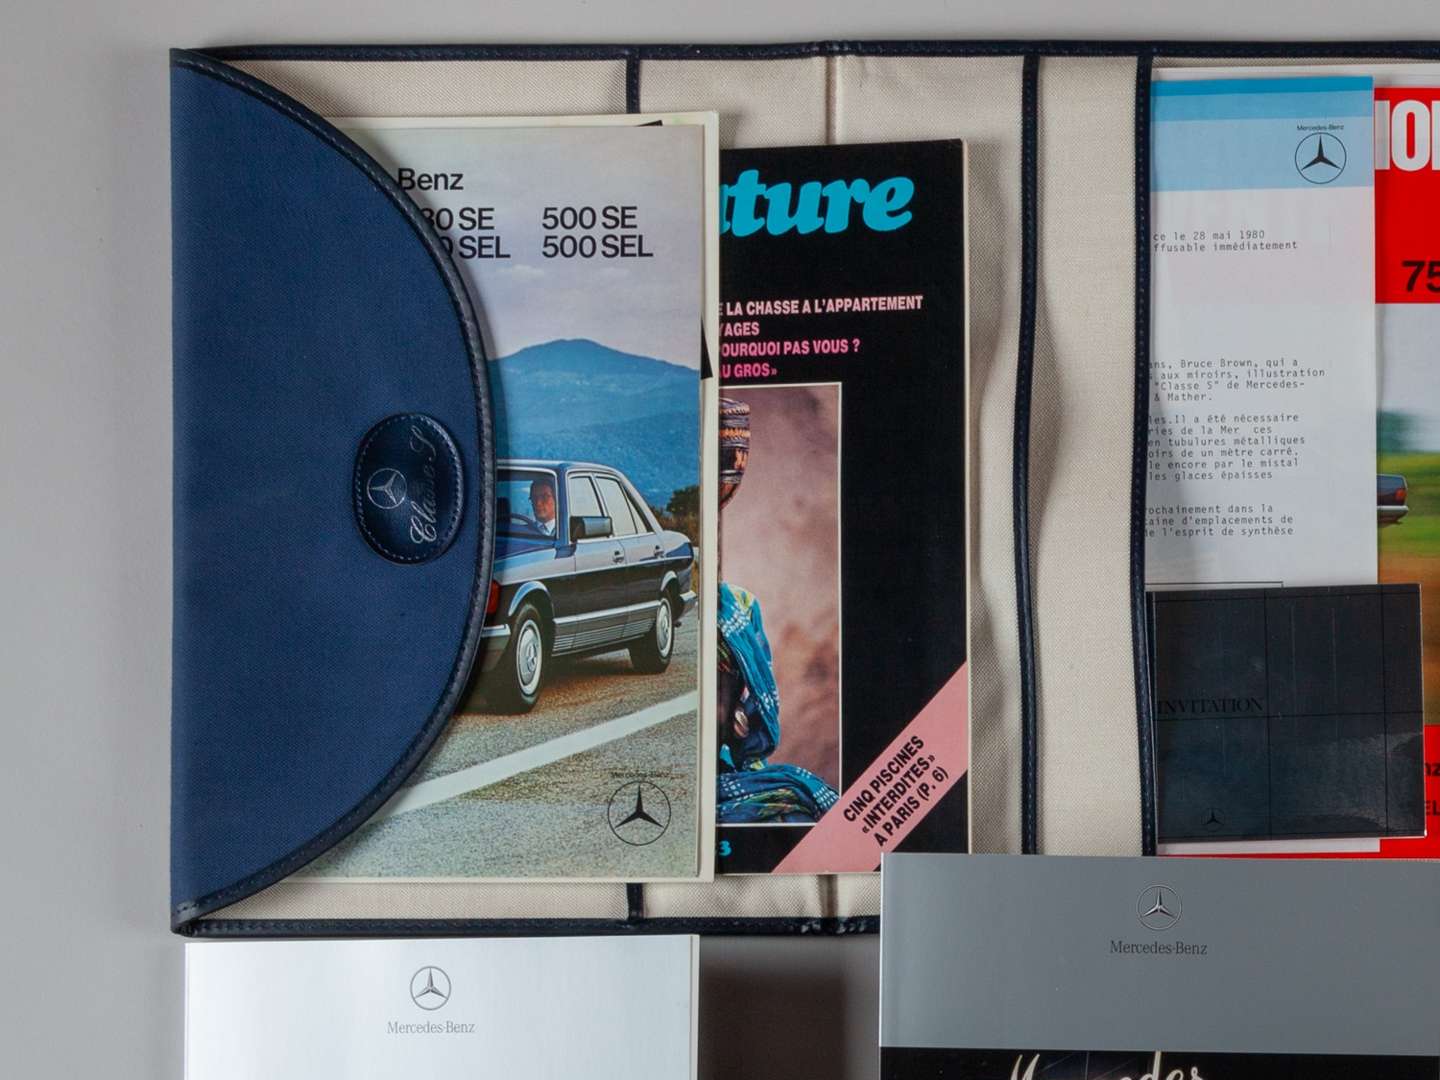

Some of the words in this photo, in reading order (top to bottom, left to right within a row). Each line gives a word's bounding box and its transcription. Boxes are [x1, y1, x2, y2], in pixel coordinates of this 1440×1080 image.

[459, 208, 494, 230] SE
[542, 207, 596, 230] 500
[601, 206, 638, 229] SE
[1193, 231, 1205, 240] 28
[1213, 231, 1231, 240] mai
[459, 235, 510, 258] SEL
[542, 235, 596, 258] 500
[601, 235, 653, 257] SEL
[727, 303, 743, 316] LA
[746, 300, 799, 315] CHASSE
[802, 300, 811, 313] A
[720, 342, 780, 357] OURQUOI
[784, 341, 809, 355] PAS
[813, 339, 848, 354] VOUS
[1226, 380, 1240, 390] de
[1180, 425, 1193, 435] de
[1180, 448, 1193, 458] de
[1214, 460, 1234, 470] par
[1228, 504, 1254, 513] dans
[1280, 516, 1294, 524] de
[1222, 526, 1234, 536] de
[843, 786, 875, 823] CINQ
[871, 735, 924, 792] PISCINES
[885, 797, 921, 837] PARIS
[1110, 941, 1208, 955] Mercedes-Benz
[387, 1021, 475, 1034] Mercedes-Benz
